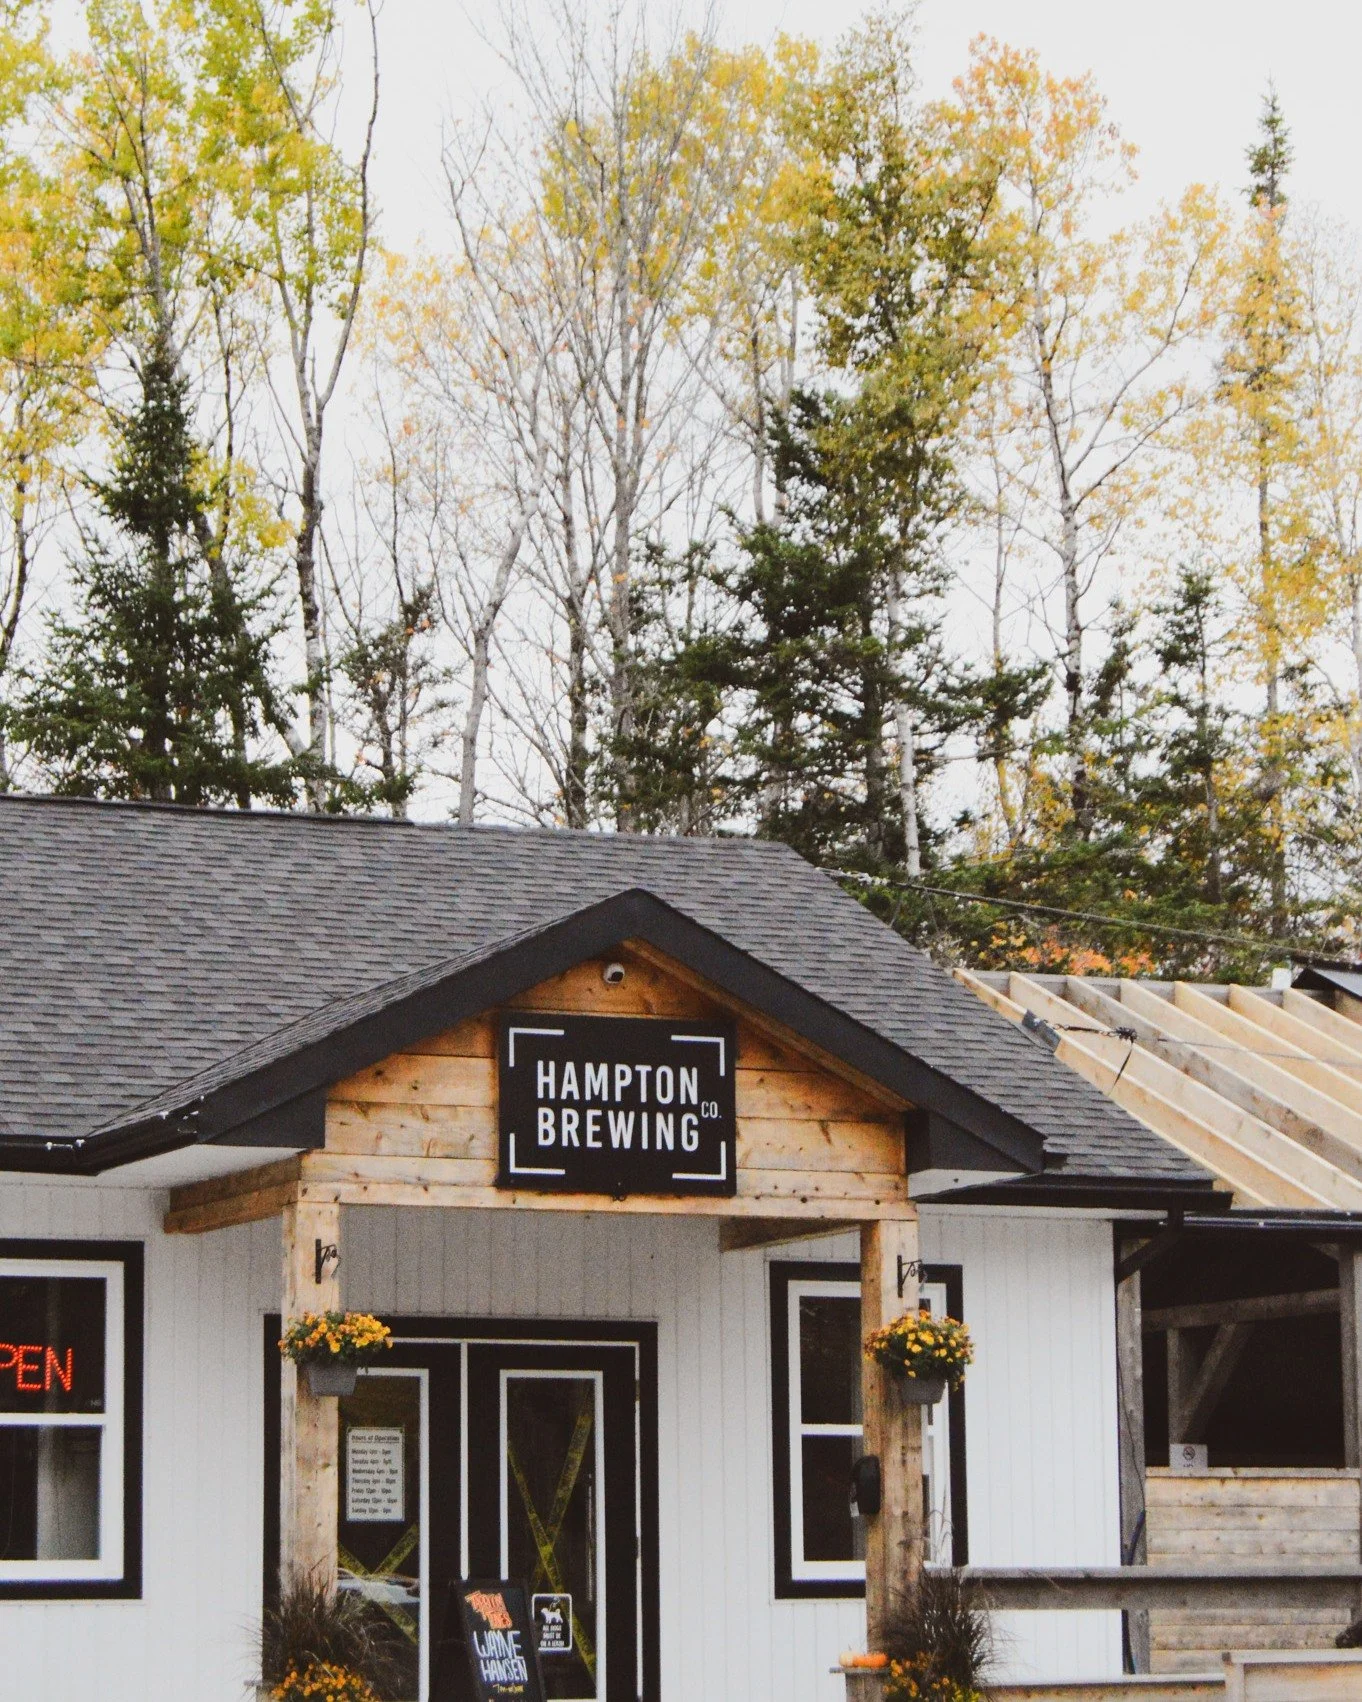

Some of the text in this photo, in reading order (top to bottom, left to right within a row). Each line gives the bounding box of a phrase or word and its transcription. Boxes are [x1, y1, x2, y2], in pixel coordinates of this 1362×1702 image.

[537, 1060, 698, 1105] HAMPTON
[537, 1101, 722, 1152] BREWING CO.
[473, 1630, 524, 1660] WAYNE
[480, 1658, 528, 1682] HANSEN
